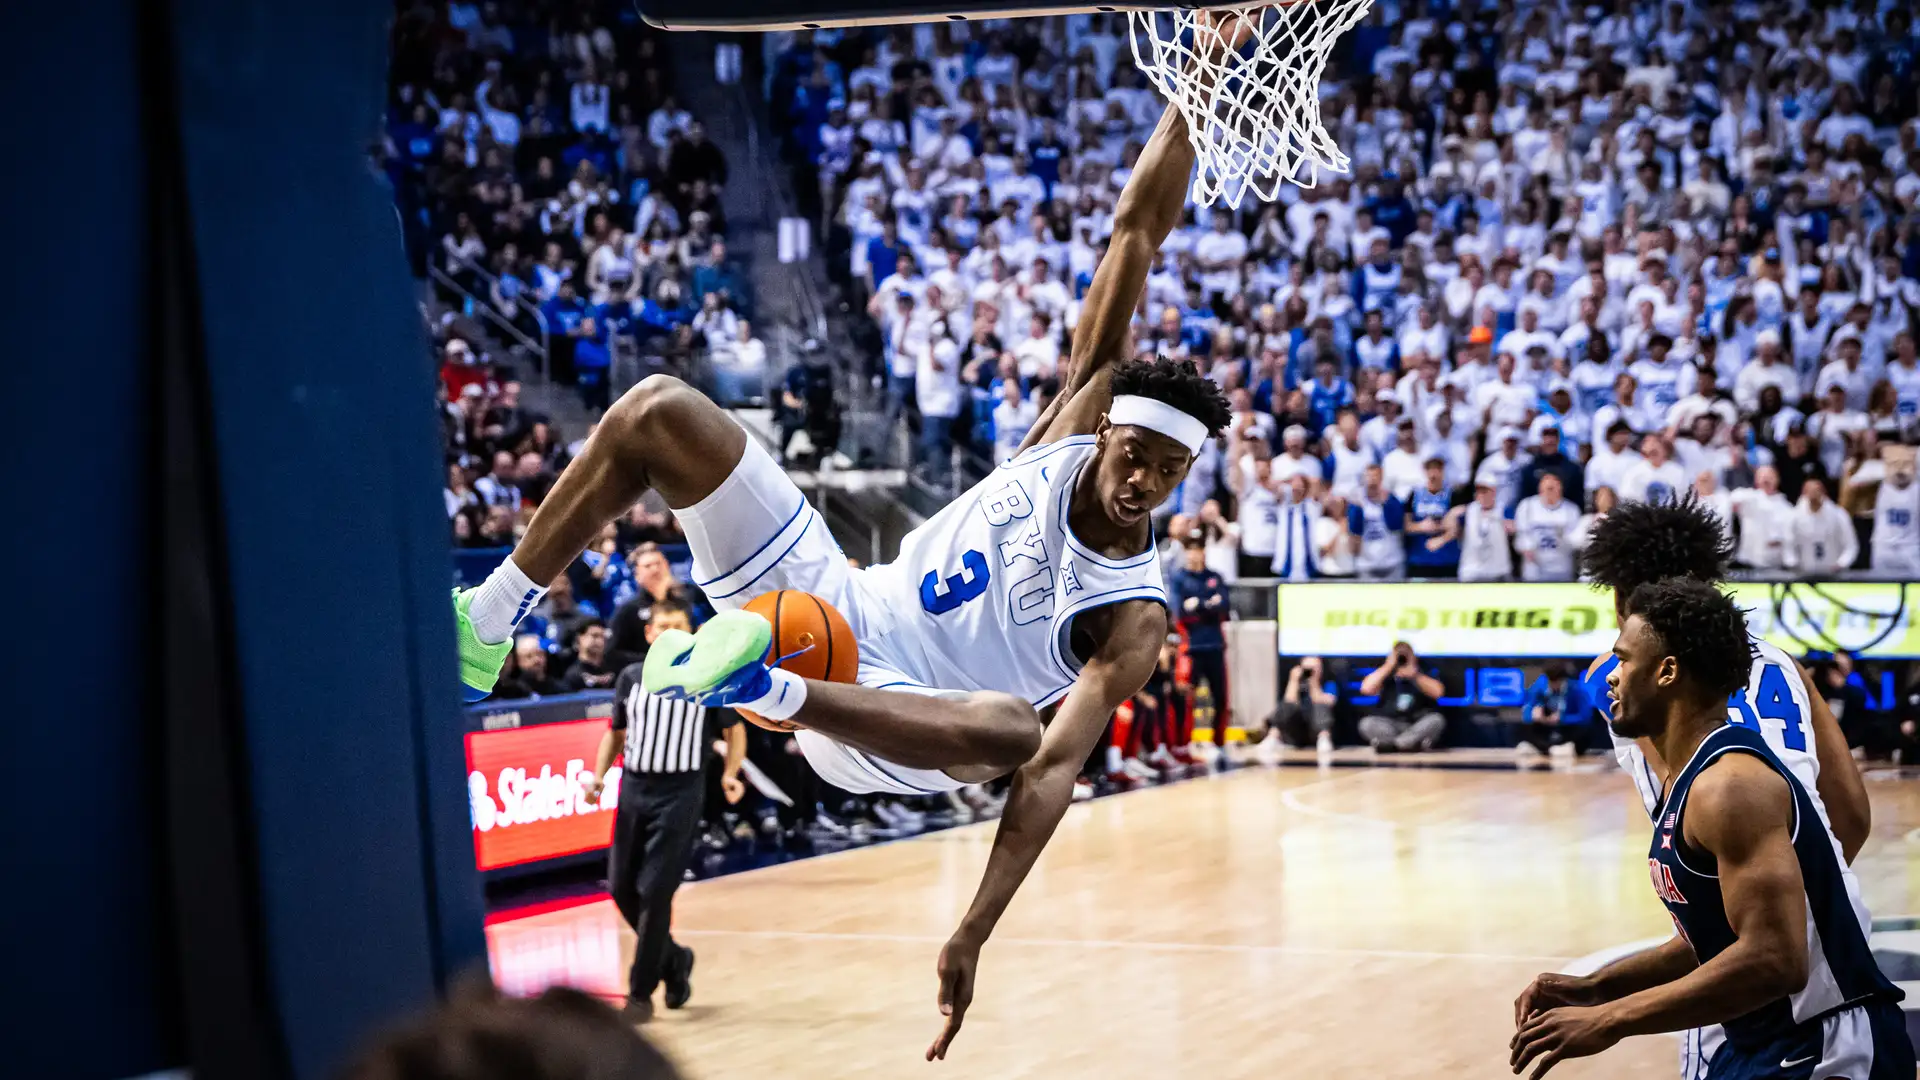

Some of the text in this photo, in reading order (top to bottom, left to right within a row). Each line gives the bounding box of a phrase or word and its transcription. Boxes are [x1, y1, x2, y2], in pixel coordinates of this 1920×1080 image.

[919, 548, 991, 616] 3
[979, 480, 1056, 626] BYU
[1475, 609, 1550, 628] BIG
